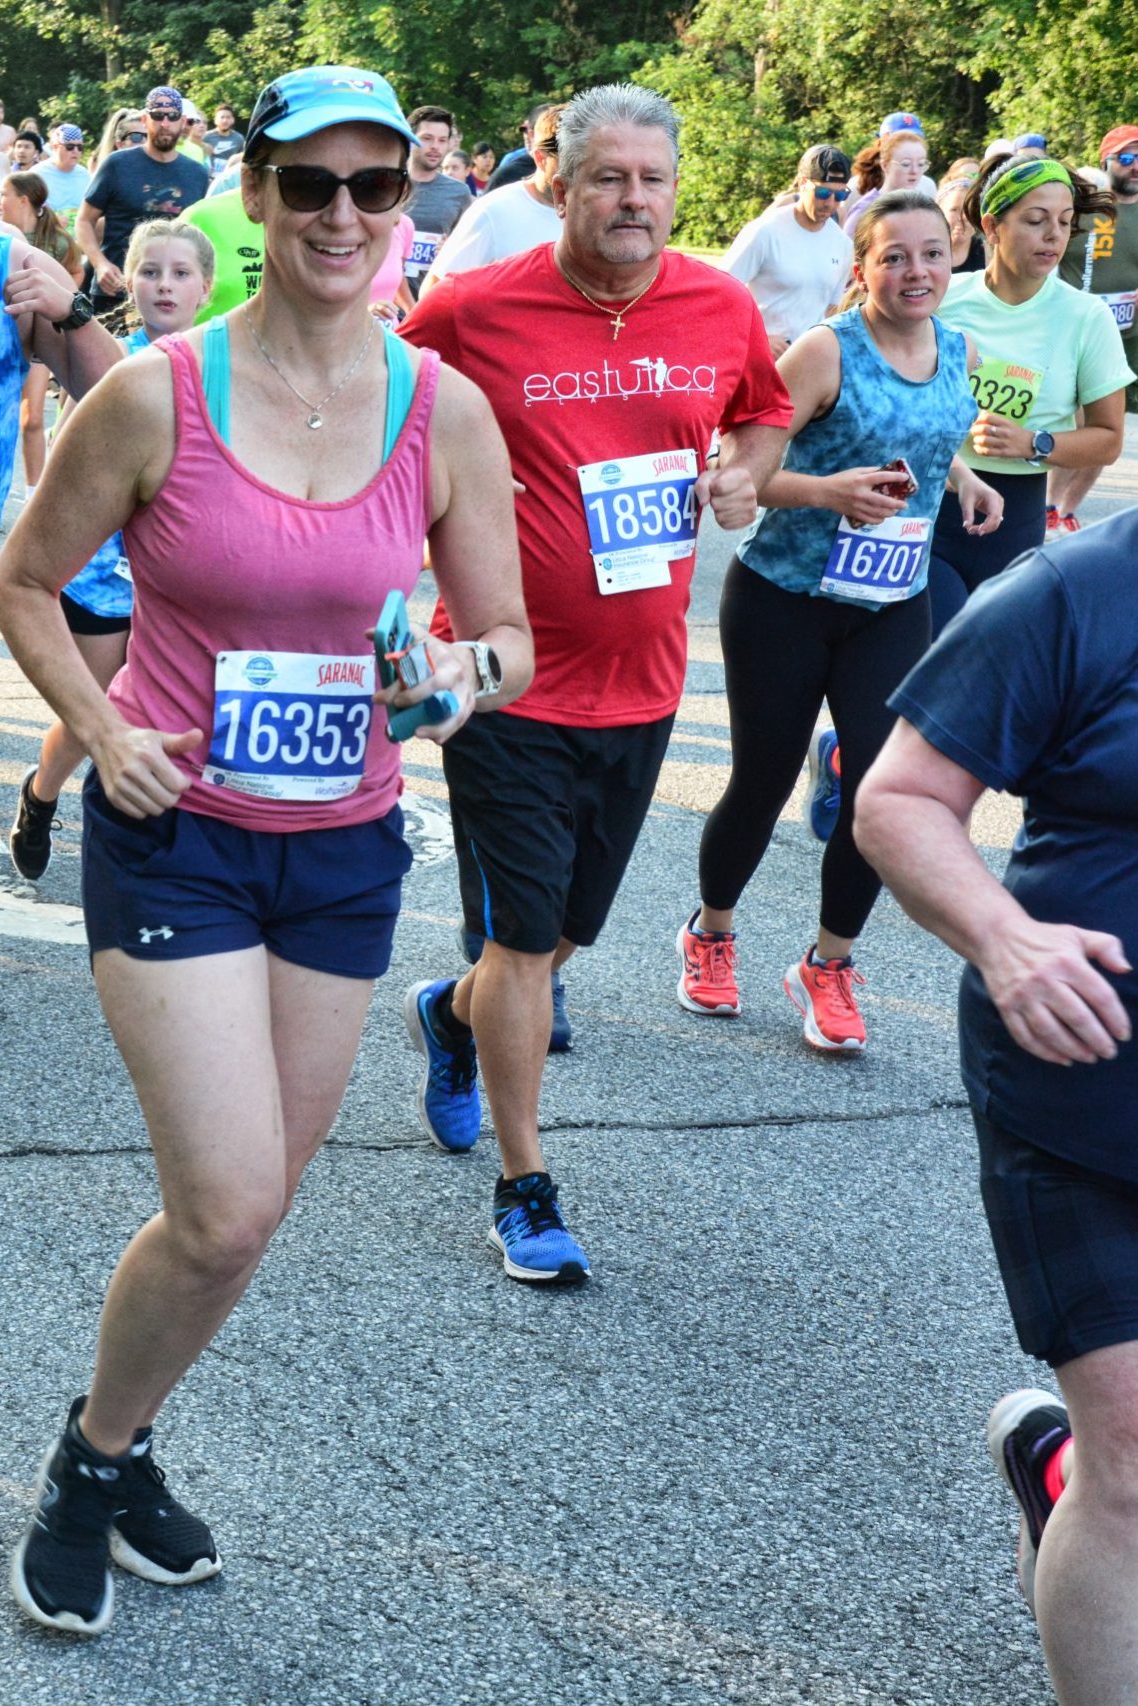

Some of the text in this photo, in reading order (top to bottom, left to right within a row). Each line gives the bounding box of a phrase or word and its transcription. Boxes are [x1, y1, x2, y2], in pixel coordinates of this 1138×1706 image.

[1092, 217, 1116, 260] 15K
[651, 454, 690, 478] SARANAC
[588, 485, 698, 544] 18584
[834, 536, 923, 583] 16701
[316, 662, 366, 688] SARANAC
[219, 698, 370, 766] 16353
